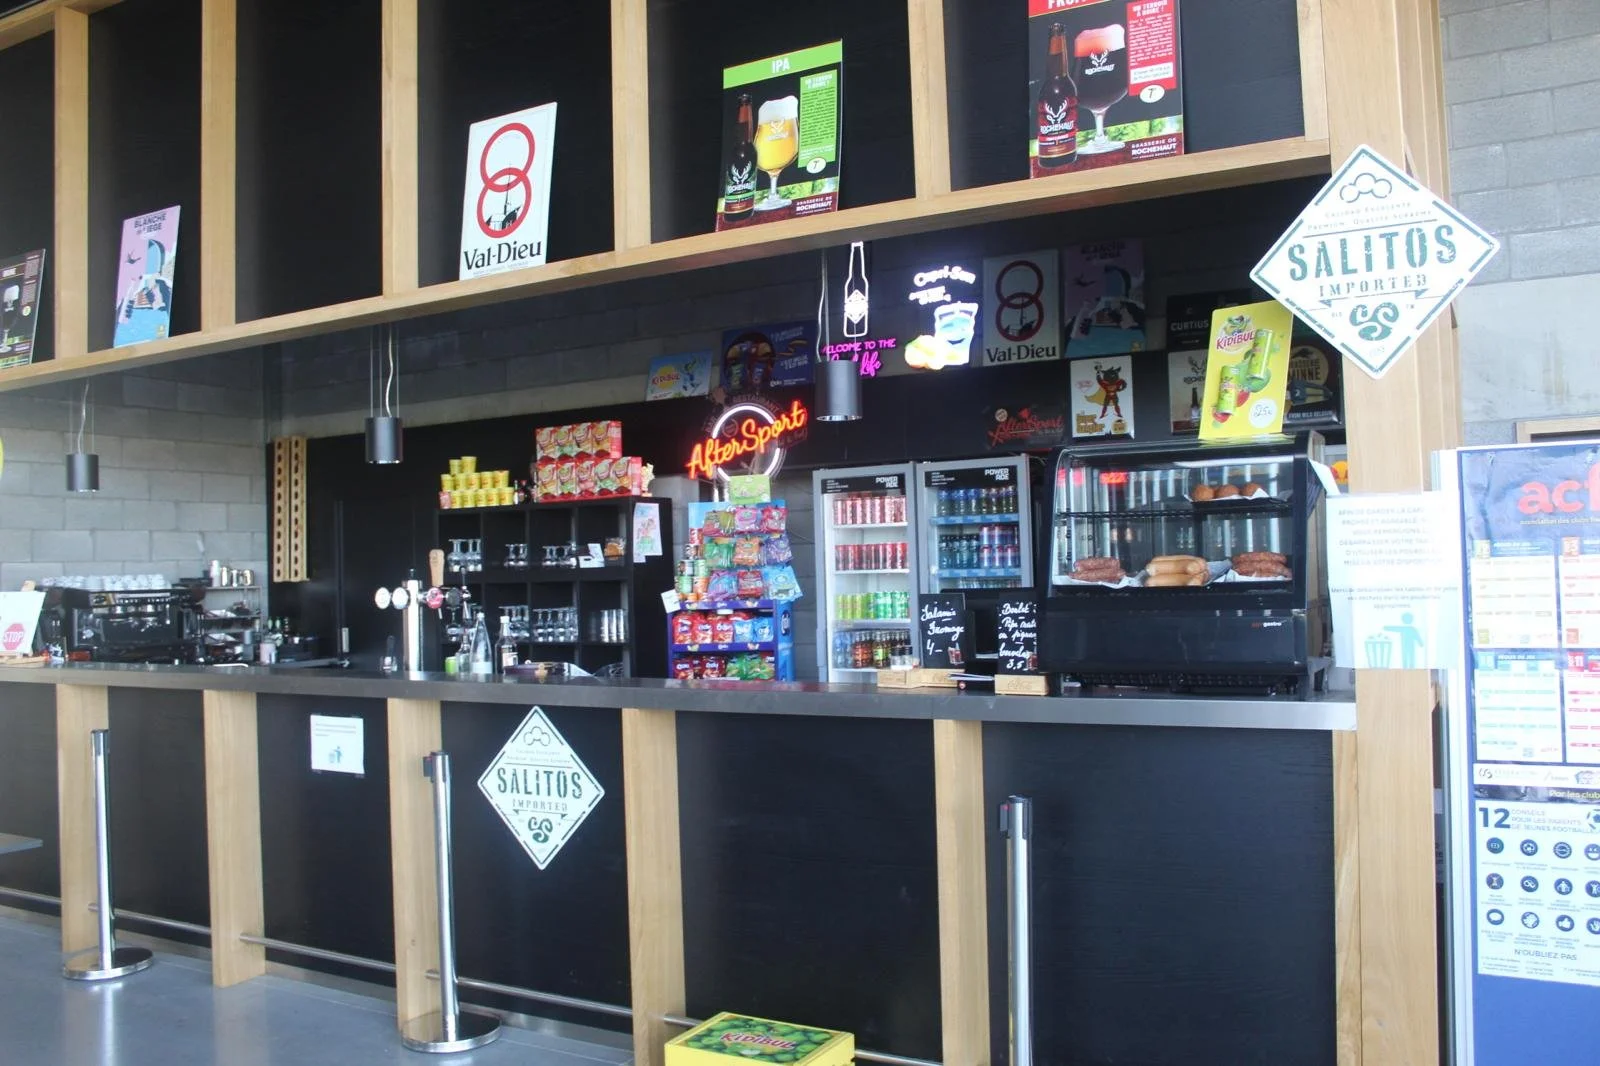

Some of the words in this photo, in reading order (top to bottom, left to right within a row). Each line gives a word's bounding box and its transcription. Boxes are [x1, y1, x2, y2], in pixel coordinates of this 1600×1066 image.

[771, 58, 790, 74] IPA
[1131, 142, 1177, 156] ROCHEHAUT
[795, 201, 832, 212] ROCHEHAUT
[134, 213, 167, 229] BLANCHE
[464, 240, 542, 270] Val-Dieu
[1287, 225, 1457, 281] SALITOS
[1319, 274, 1427, 297] IMPORTED
[1170, 319, 1209, 332] CURTIUS
[865, 340, 876, 349] TO
[878, 338, 896, 349] THE
[986, 343, 1056, 363] Val-Dieu
[984, 468, 1009, 476] POWER
[876, 476, 898, 484] POWER
[497, 767, 582, 799] SALITOS
[512, 798, 568, 811] IMPORTED
[1479, 807, 1510, 829] 12
[1514, 948, 1558, 960] N'OUBLIEZ
[1560, 952, 1577, 961] PAS
